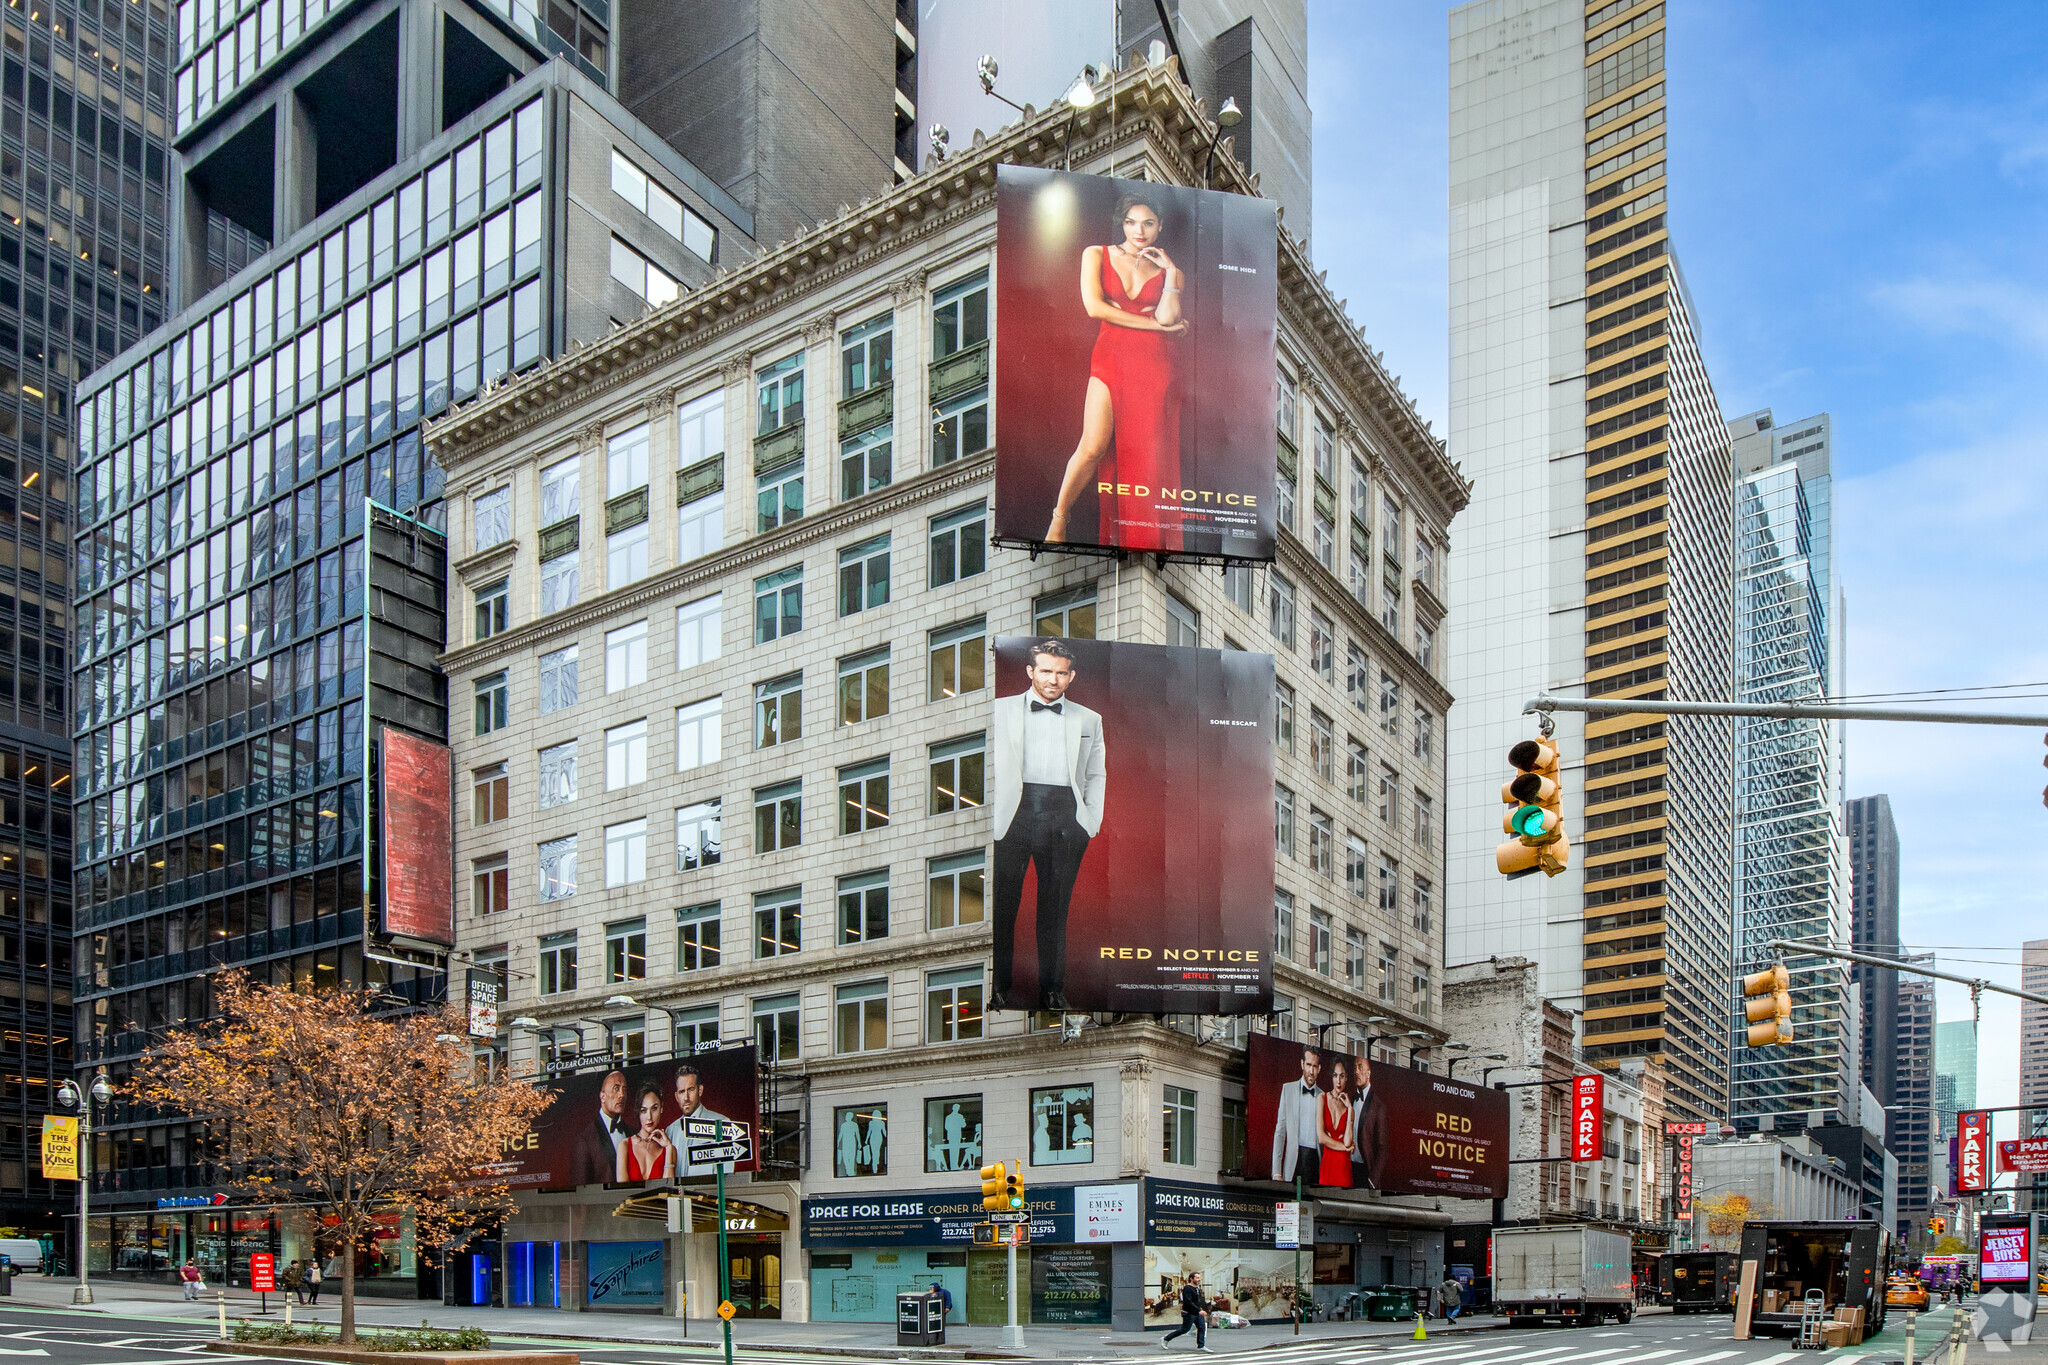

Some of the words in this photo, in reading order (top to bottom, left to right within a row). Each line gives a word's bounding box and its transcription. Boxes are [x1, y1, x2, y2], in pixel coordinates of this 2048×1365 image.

[1218, 264, 1238, 272] SOME
[1240, 266, 1256, 274] HIDE
[1098, 482, 1150, 497] RED
[1162, 488, 1258, 507] NOTICE
[1181, 512, 1206, 520] NETFLIX
[1100, 947, 1152, 960] RED
[1164, 949, 1259, 962] NOTICE
[472, 980, 497, 994] OFFICE
[472, 990, 497, 1003] SPACE
[695, 1039, 721, 1051] 022178
[1433, 1082, 1445, 1092] PRO
[1446, 1085, 1459, 1095] AND
[1460, 1088, 1475, 1099] CONS
[1436, 1112, 1472, 1134] RED
[1579, 1096, 1595, 1146] PARK
[695, 1125, 713, 1133] ONE
[722, 1128, 739, 1136] WAY
[1667, 1123, 1707, 1134] ROSIE
[48, 1143, 71, 1153] LION
[697, 1150, 715, 1159] ONE
[723, 1147, 741, 1156] WAY
[1420, 1139, 1486, 1164] NOTICE
[1963, 1128, 1980, 1177] PARK
[45, 1154, 74, 1165] KING
[809, 1206, 848, 1218] SPACE
[852, 1205, 880, 1217] FOR
[884, 1203, 923, 1216] LEASE
[928, 1203, 970, 1214] CORNER
[1089, 1200, 1123, 1208] EMMES
[1155, 1194, 1181, 1206] SPACE
[1183, 1196, 1200, 1208] FOR
[1202, 1198, 1224, 1210] LEASE
[1226, 1202, 1247, 1212] CORNER
[1249, 1205, 1264, 1214] RETAIL
[725, 1218, 755, 1230] 1674
[1985, 1235, 2024, 1251] JERSEY
[1992, 1248, 2021, 1262] BOYS
[589, 1248, 662, 1300] Sapphire
[1044, 1291, 1100, 1299] 212.776.1246
